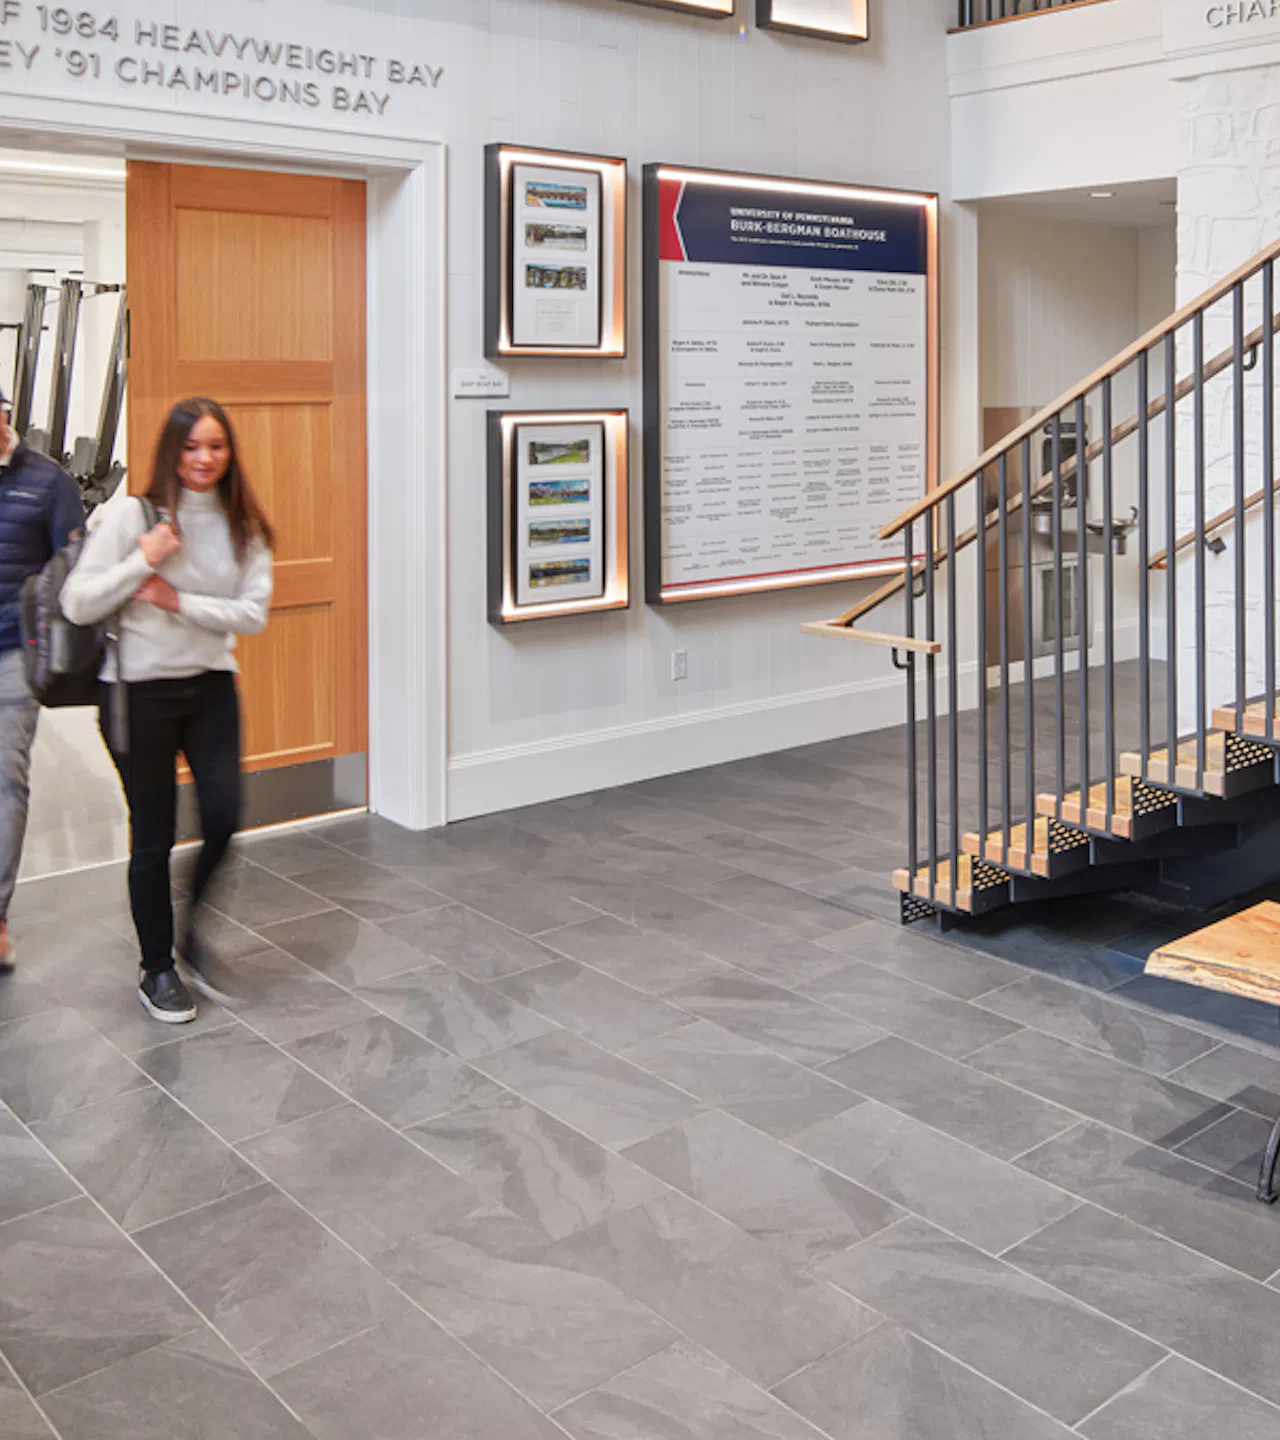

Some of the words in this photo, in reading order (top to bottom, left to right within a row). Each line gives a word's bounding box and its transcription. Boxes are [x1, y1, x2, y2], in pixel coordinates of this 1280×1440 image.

[36, 3, 120, 43] 1984
[134, 19, 376, 80] HEAVYWEIGHT
[387, 58, 445, 89] BAY
[54, 46, 101, 80] '91
[114, 56, 321, 109] CHAMPIONS
[331, 85, 392, 116] BAY
[729, 207, 781, 220] UNIVERSITY
[782, 211, 793, 221] OF
[795, 212, 855, 226] PENNSYLVANIA
[730, 219, 821, 237] BURK-BERGMAN
[824, 226, 887, 242] BOATHOUSE
